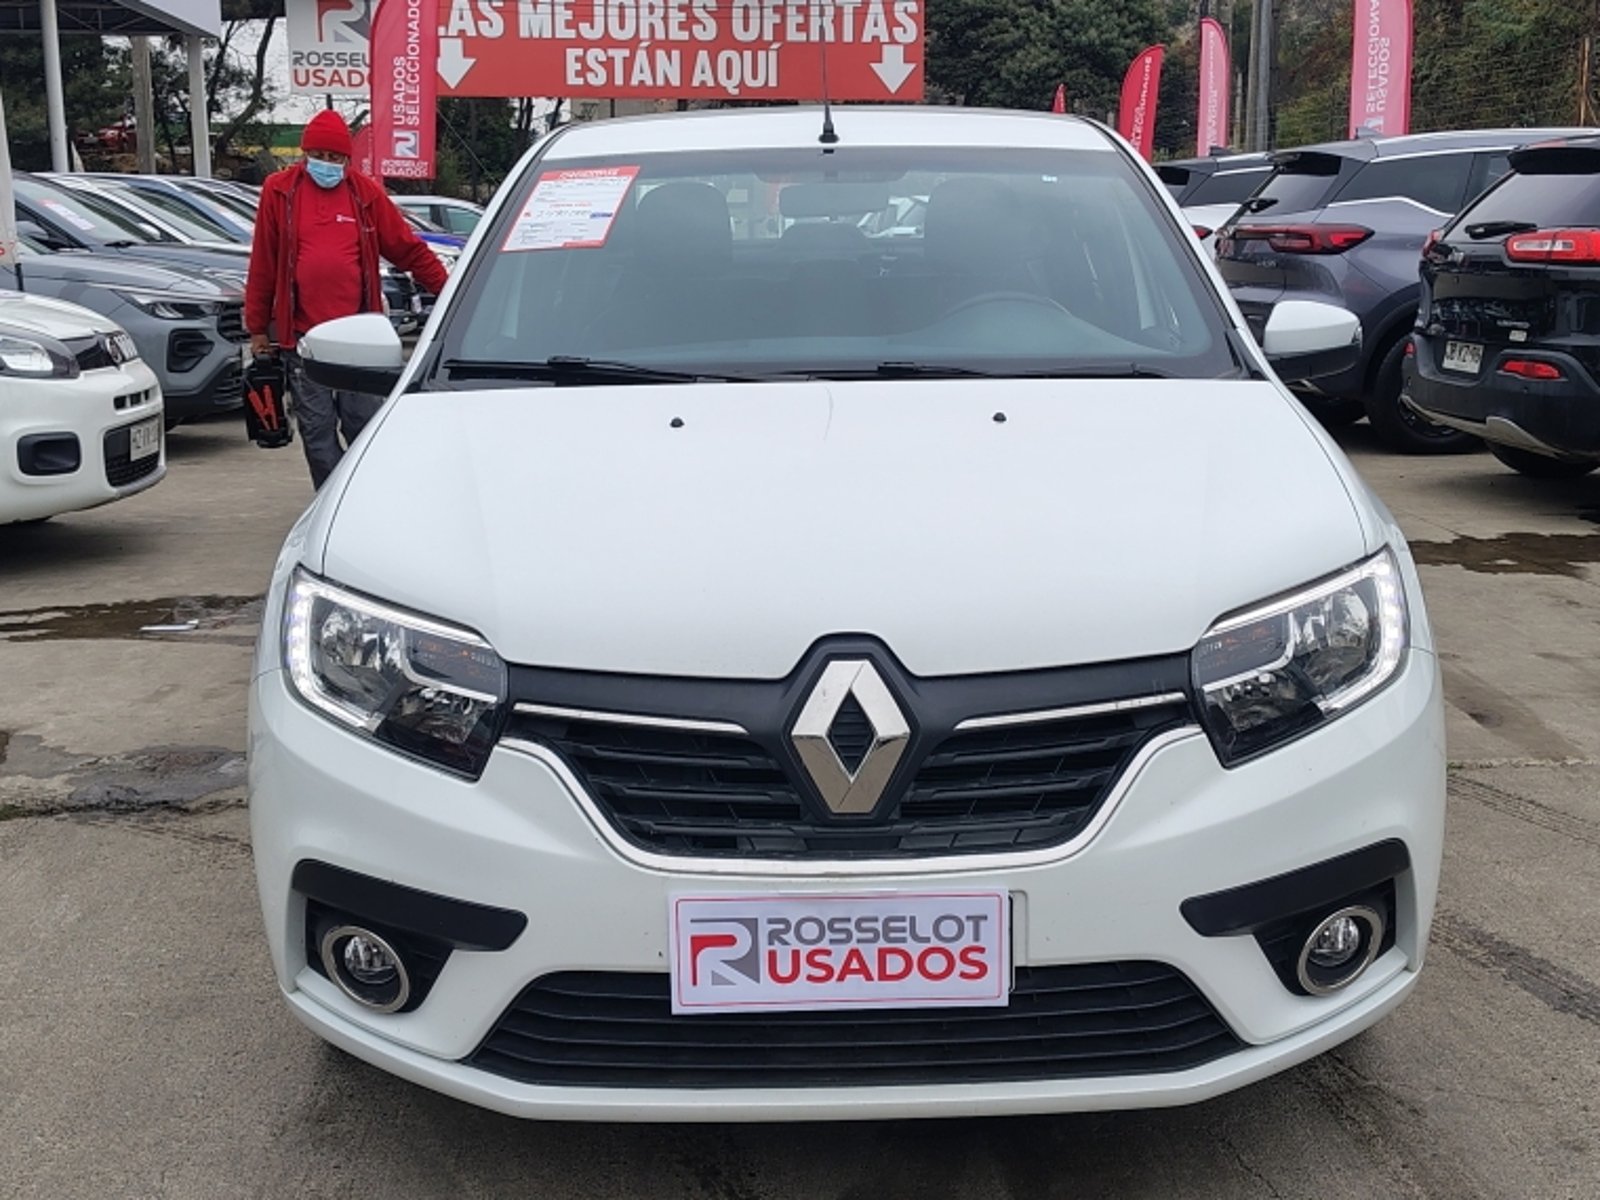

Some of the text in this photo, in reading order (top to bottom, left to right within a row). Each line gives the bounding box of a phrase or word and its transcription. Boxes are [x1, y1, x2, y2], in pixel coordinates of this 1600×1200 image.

[437, 0, 919, 44] AS MEJORES OFERTAS
[293, 68, 371, 88] USAD
[565, 40, 782, 95] ESTÁN AQUÍ
[392, 56, 406, 126] USADOS
[766, 914, 988, 945] ROSSELOT
[767, 946, 988, 984] USADOS
